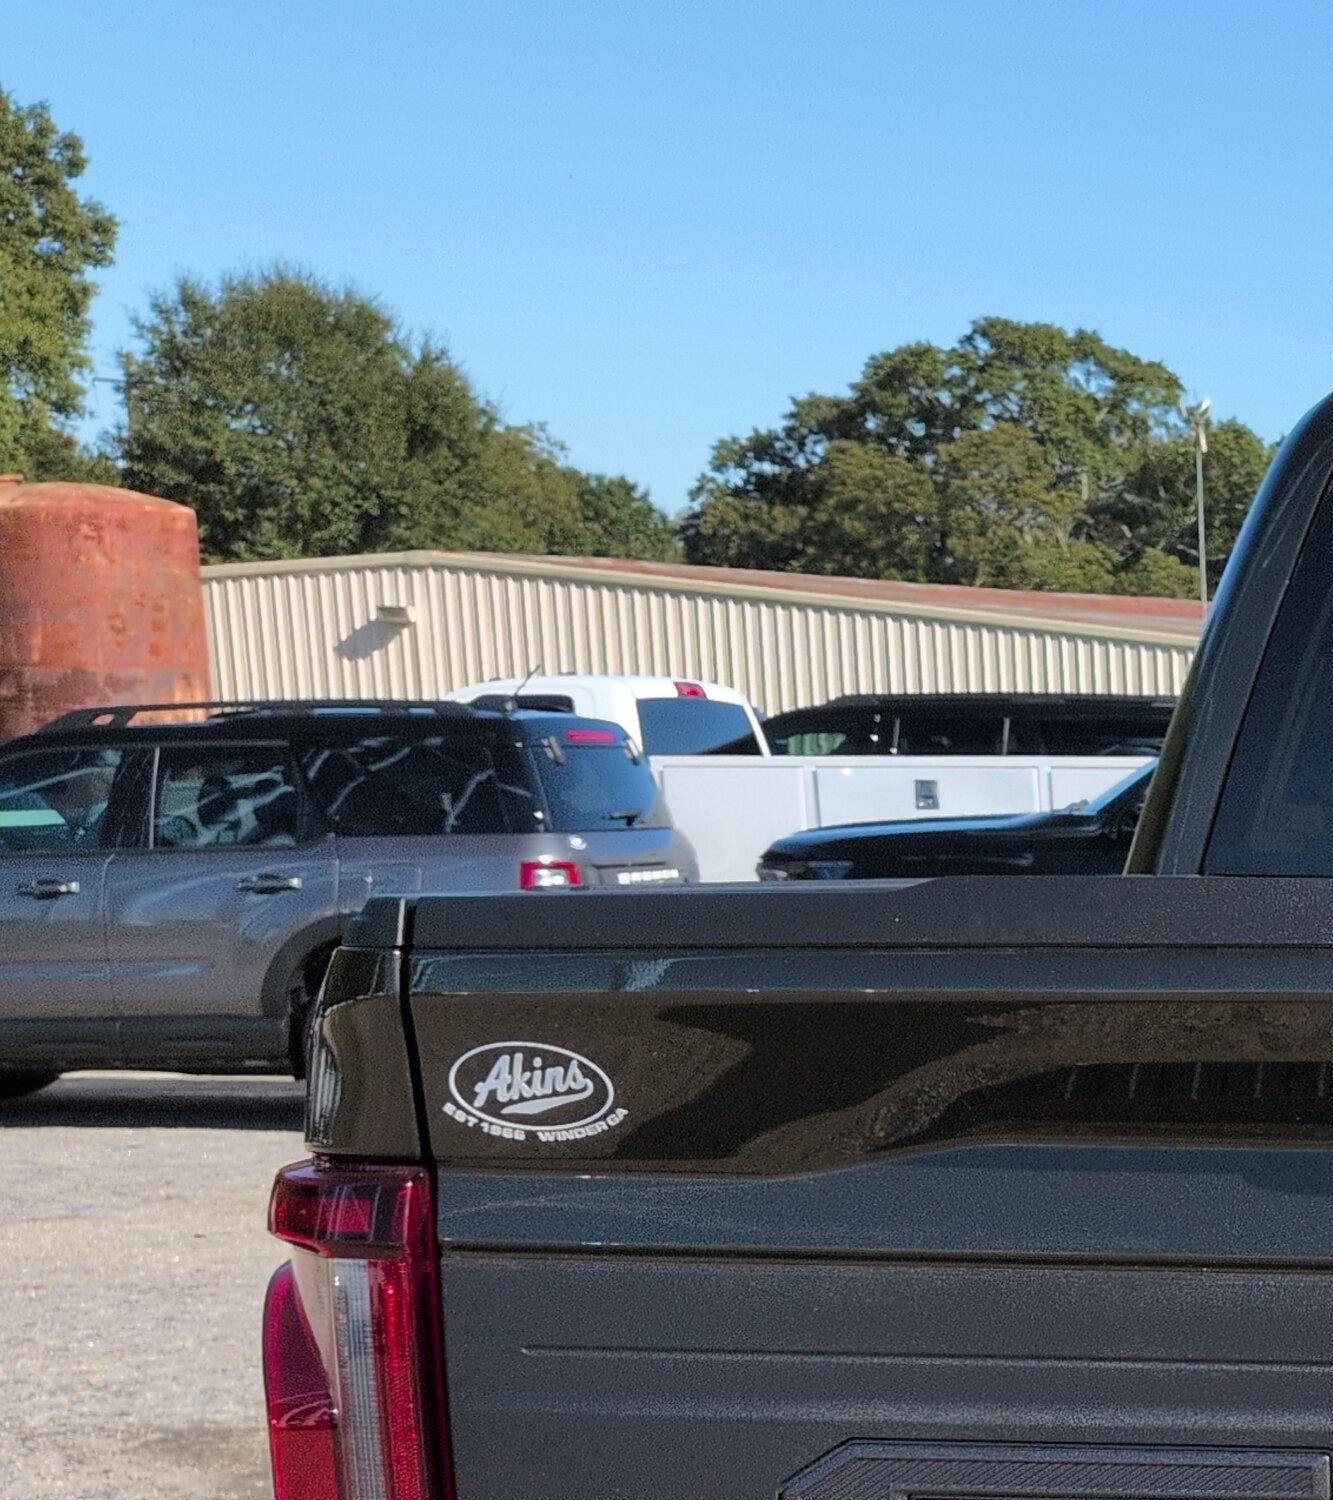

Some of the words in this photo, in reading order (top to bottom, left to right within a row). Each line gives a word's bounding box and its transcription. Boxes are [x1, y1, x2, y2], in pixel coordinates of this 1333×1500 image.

[473, 1053, 594, 1114] Akins
[442, 1102, 478, 1127] EST
[537, 1122, 609, 1142] WINDER
[606, 1107, 630, 1127] GA
